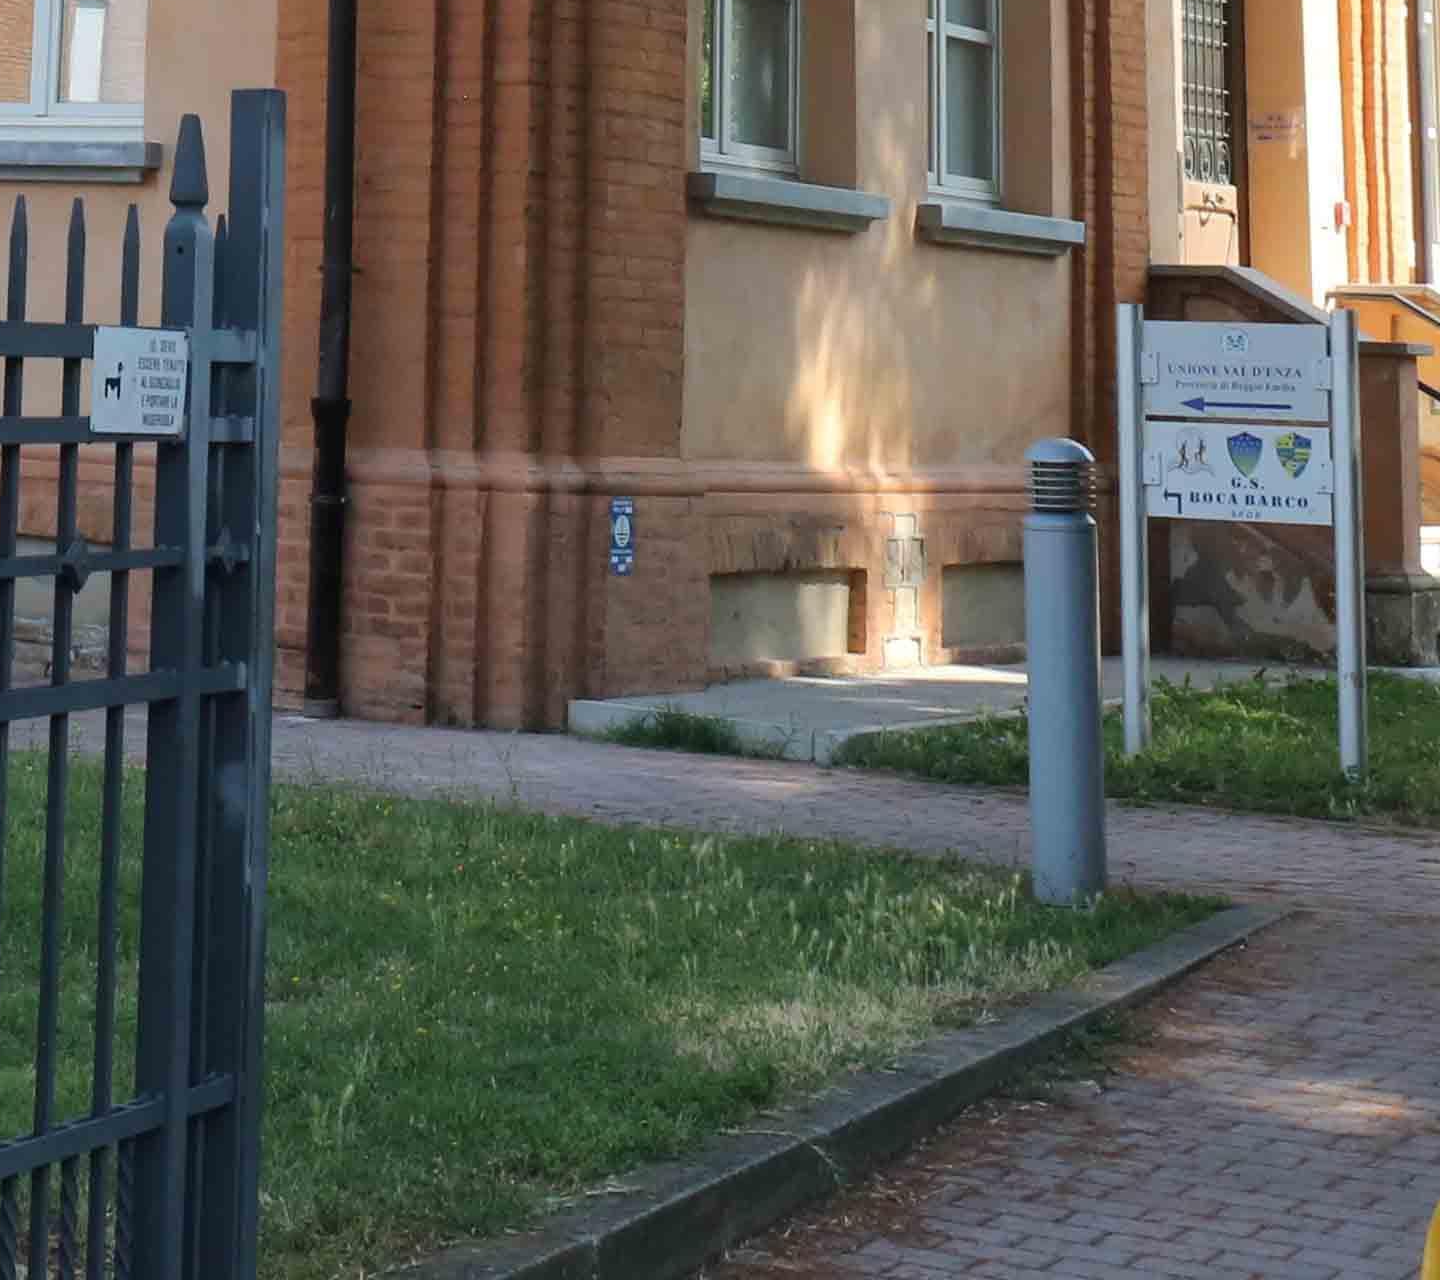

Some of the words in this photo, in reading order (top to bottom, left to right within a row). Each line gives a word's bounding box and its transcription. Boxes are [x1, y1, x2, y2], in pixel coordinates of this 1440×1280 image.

[1167, 361, 1216, 376] UNIONE
[1189, 490, 1238, 505] BOCA
[1244, 493, 1308, 509] BARCO
